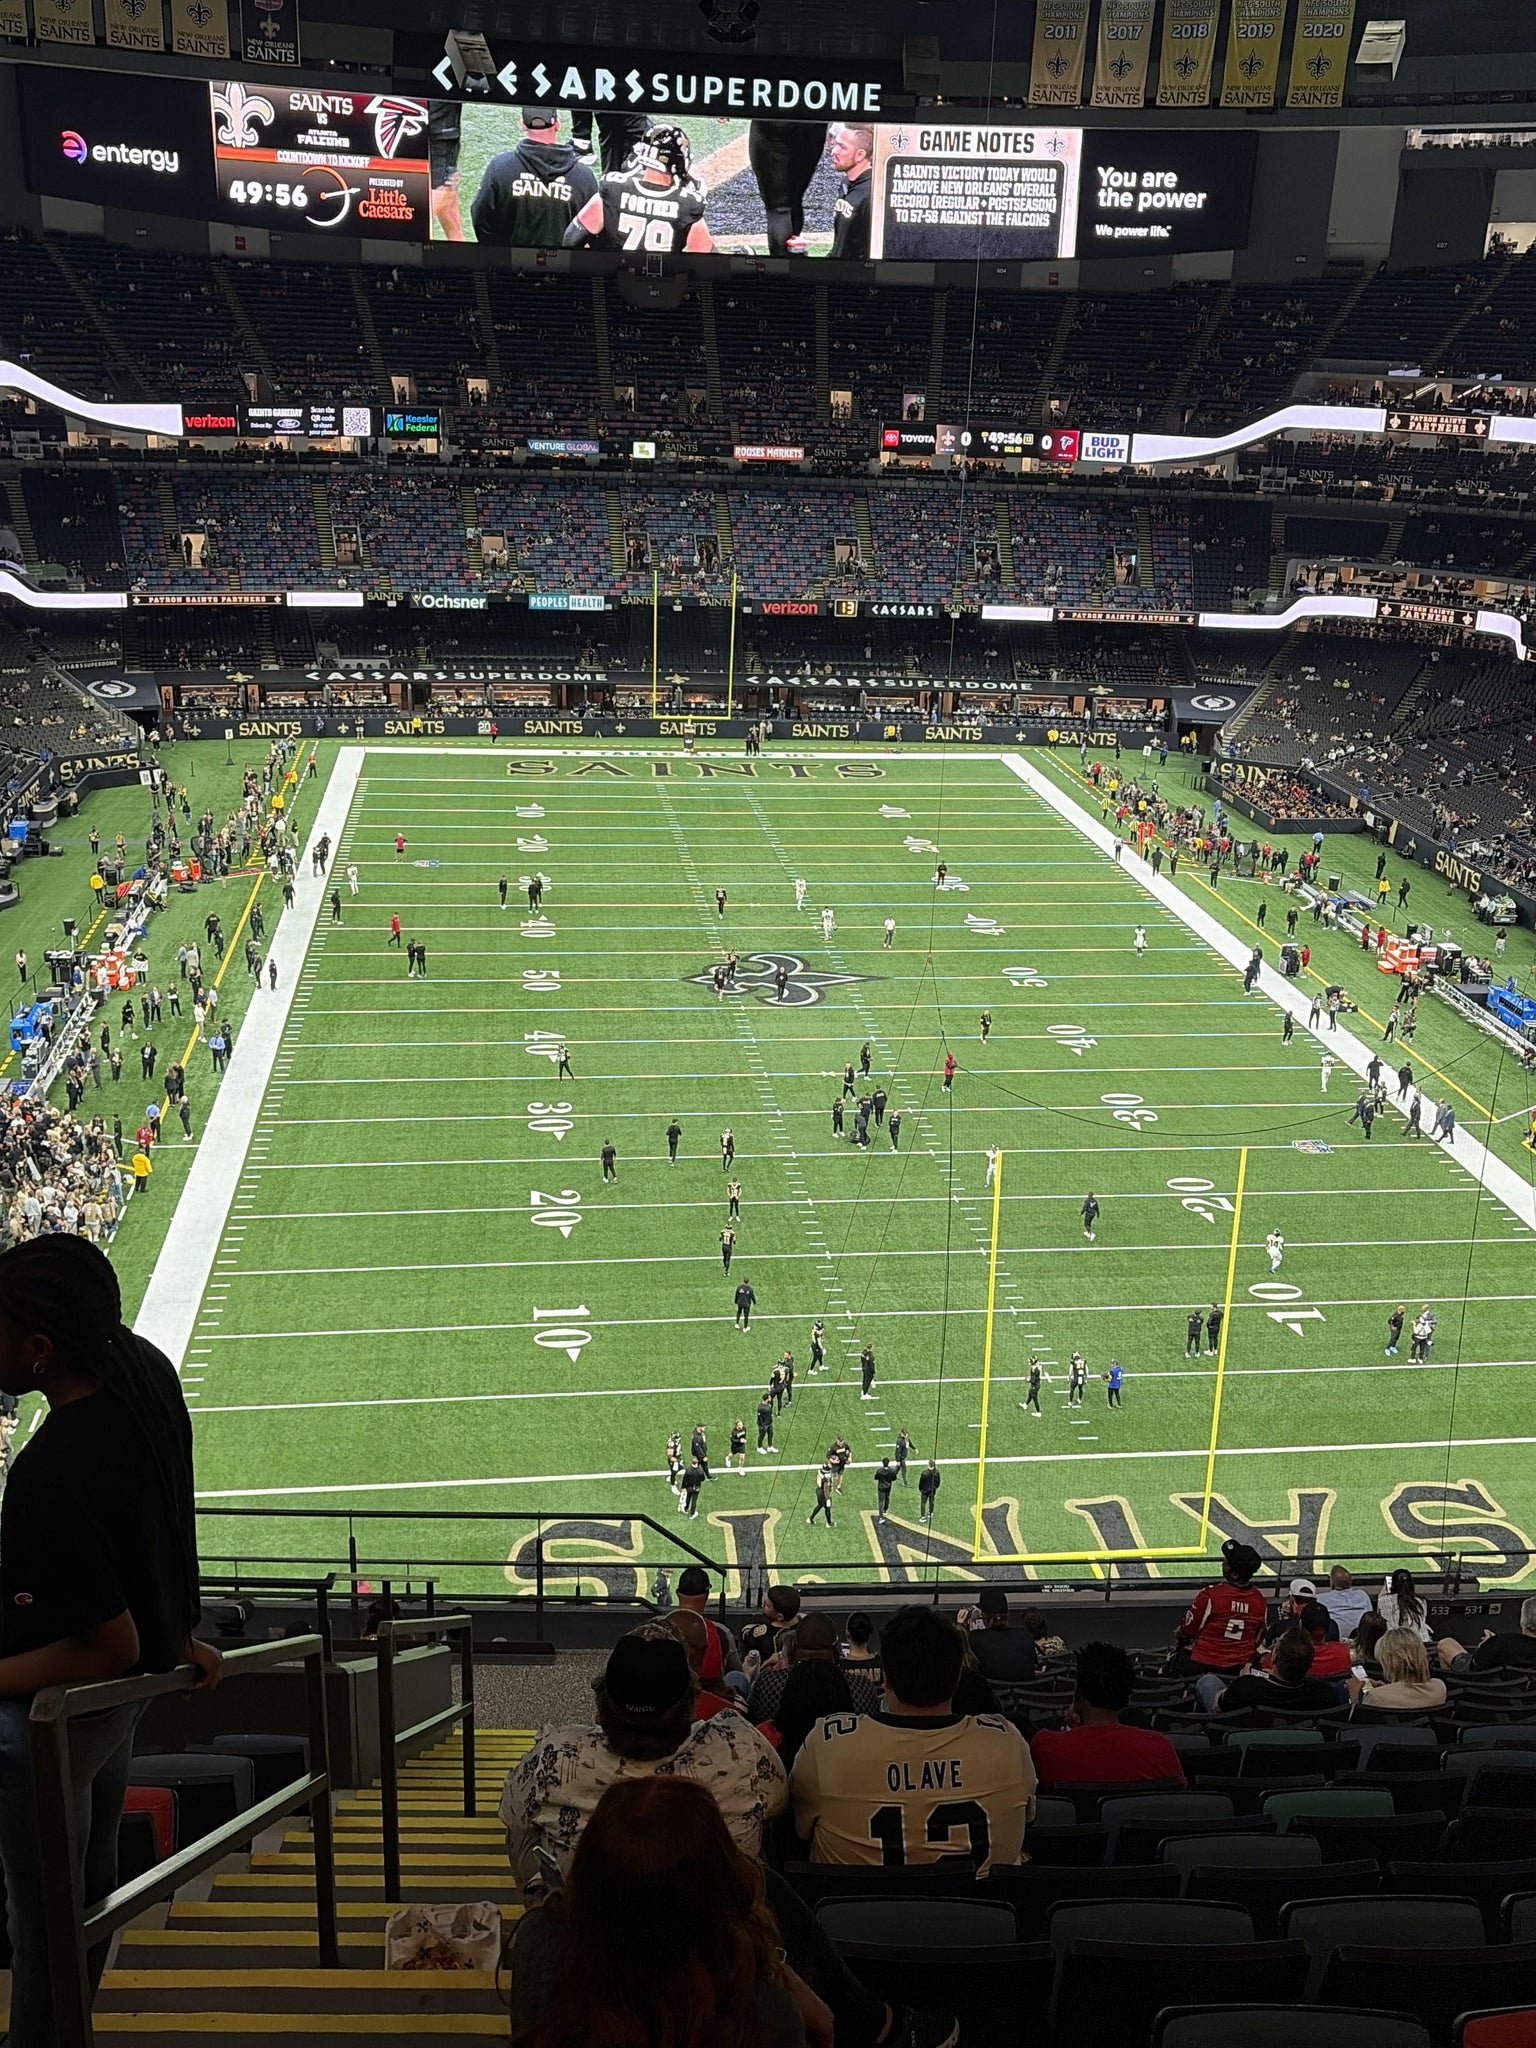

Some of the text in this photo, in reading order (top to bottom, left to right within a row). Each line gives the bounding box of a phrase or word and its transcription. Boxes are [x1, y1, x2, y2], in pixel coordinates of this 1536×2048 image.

[1041, 10, 1084, 19] CHAMPIONS
[1106, 10, 1149, 19] CHAMPIONS
[1169, 9, 1215, 19] CHAMPIONS
[1236, 8, 1281, 16] CHAMPIONS
[1303, 8, 1349, 16] CHAMPIONS
[40, 23, 90, 41] SAINTS
[1044, 24, 1078, 39] 2011
[1107, 24, 1143, 40] 2017
[1171, 24, 1209, 39] 2018
[1237, 23, 1274, 38] 2019
[1303, 22, 1344, 38] 2020
[110, 30, 160, 48] SAINTS
[247, 38, 295, 49] NEW ORLEANS
[177, 38, 226, 55] SAINTS
[247, 45, 296, 62] SAINTS
[652, 73, 882, 112] SUPERDOME
[1032, 90, 1077, 103] SAINTS
[1094, 91, 1140, 105] SAINTS
[1160, 91, 1206, 105] SAINTS
[1225, 91, 1271, 105] SAINTS
[1291, 92, 1338, 105] SAINTS
[289, 93, 354, 116] SAINTS
[316, 113, 329, 125] VS
[308, 129, 338, 137] ATLANTA
[297, 134, 350, 148] FALCONS
[919, 130, 1035, 154] GAME NOTES
[92, 143, 180, 173] entergy
[276, 150, 371, 168] COUNTDOWN TO KICKOFF
[893, 165, 1057, 182] A SAINTS VICTORY TODAY WOULD
[1097, 166, 1178, 188] You are
[229, 180, 309, 208] 49:56
[512, 179, 572, 202] SAINTS
[892, 179, 1056, 197] IMPROVE NEW ORLEANS' OVERALL
[368, 187, 407, 206] Little
[890, 194, 1057, 213] RECORD (REGULAR POSTSEASON)
[1098, 187, 1207, 212] the power
[358, 200, 415, 220] Caesars
[895, 209, 909, 222] TO
[940, 210, 983, 225] AGAINST
[984, 211, 1004, 226] THE
[1005, 212, 1050, 227] FALCONS
[618, 212, 674, 252] 70
[1095, 224, 1149, 238] We power
[185, 413, 236, 429] verizon
[405, 415, 438, 425] Keesler
[1409, 415, 1467, 425] PATRON SAINTS
[405, 424, 438, 433] Federal
[1409, 421, 1467, 434] PARTNERS
[482, 438, 515, 447] SAINTS
[901, 433, 936, 444] TOYOTA
[960, 431, 972, 447] 0
[988, 432, 1023, 445] 49:56
[1041, 435, 1053, 450] 0
[1091, 436, 1119, 447] BUD
[528, 441, 599, 452] VENTURE GLOBAL
[664, 443, 698, 452] SAINTS
[735, 446, 804, 459] ROUSES MARKETS
[814, 448, 848, 458] SAINTS
[1085, 446, 1125, 460] LIGHT
[1298, 468, 1334, 480] SAINTS
[1377, 473, 1414, 485] SAINTS
[1454, 478, 1491, 490] SAINTS
[367, 591, 404, 601] SAINTS
[421, 595, 486, 609] Ochsner
[530, 596, 605, 608] PEOPLES HEALTH
[621, 596, 655, 605] SAINTS
[700, 598, 733, 607] SAINTS
[762, 601, 819, 615] verizon
[840, 601, 855, 615] 13
[871, 603, 934, 617] CAESARS
[943, 604, 979, 613] SAINTS
[1400, 605, 1455, 616] PATRON SAINTS
[1138, 614, 1180, 622] PARTNERS
[1400, 611, 1455, 624] PARTNERS
[84, 660, 118, 669] SUPERDOME
[305, 671, 608, 682] CAESARS SUPERDOME
[746, 676, 1033, 691] CAESARS SUPERDOME
[239, 721, 303, 736] SAINTS
[524, 720, 583, 734] SAINTS
[792, 725, 849, 738] SAINTS
[925, 727, 983, 741] SAINTS
[506, 759, 887, 780] SAINTS
[516, 837, 549, 852] 20
[1435, 850, 1482, 893] SAINTS
[520, 919, 556, 938] 40
[964, 917, 1006, 936] 40
[522, 969, 562, 991] 50
[1001, 966, 1048, 988] 50
[524, 1030, 566, 1055] 40
[1046, 1024, 1099, 1049] 40
[1100, 1093, 1159, 1122] 30
[527, 1101, 574, 1132] 30
[1166, 1177, 1236, 1213] 20
[530, 1189, 583, 1227] 20
[1248, 1282, 1327, 1323] 10
[532, 1304, 593, 1348] 10
[1231, 1600, 1250, 1614] RYAN
[1430, 1605, 1482, 1616] 533 531
[886, 1759, 964, 1793] OLAVE
